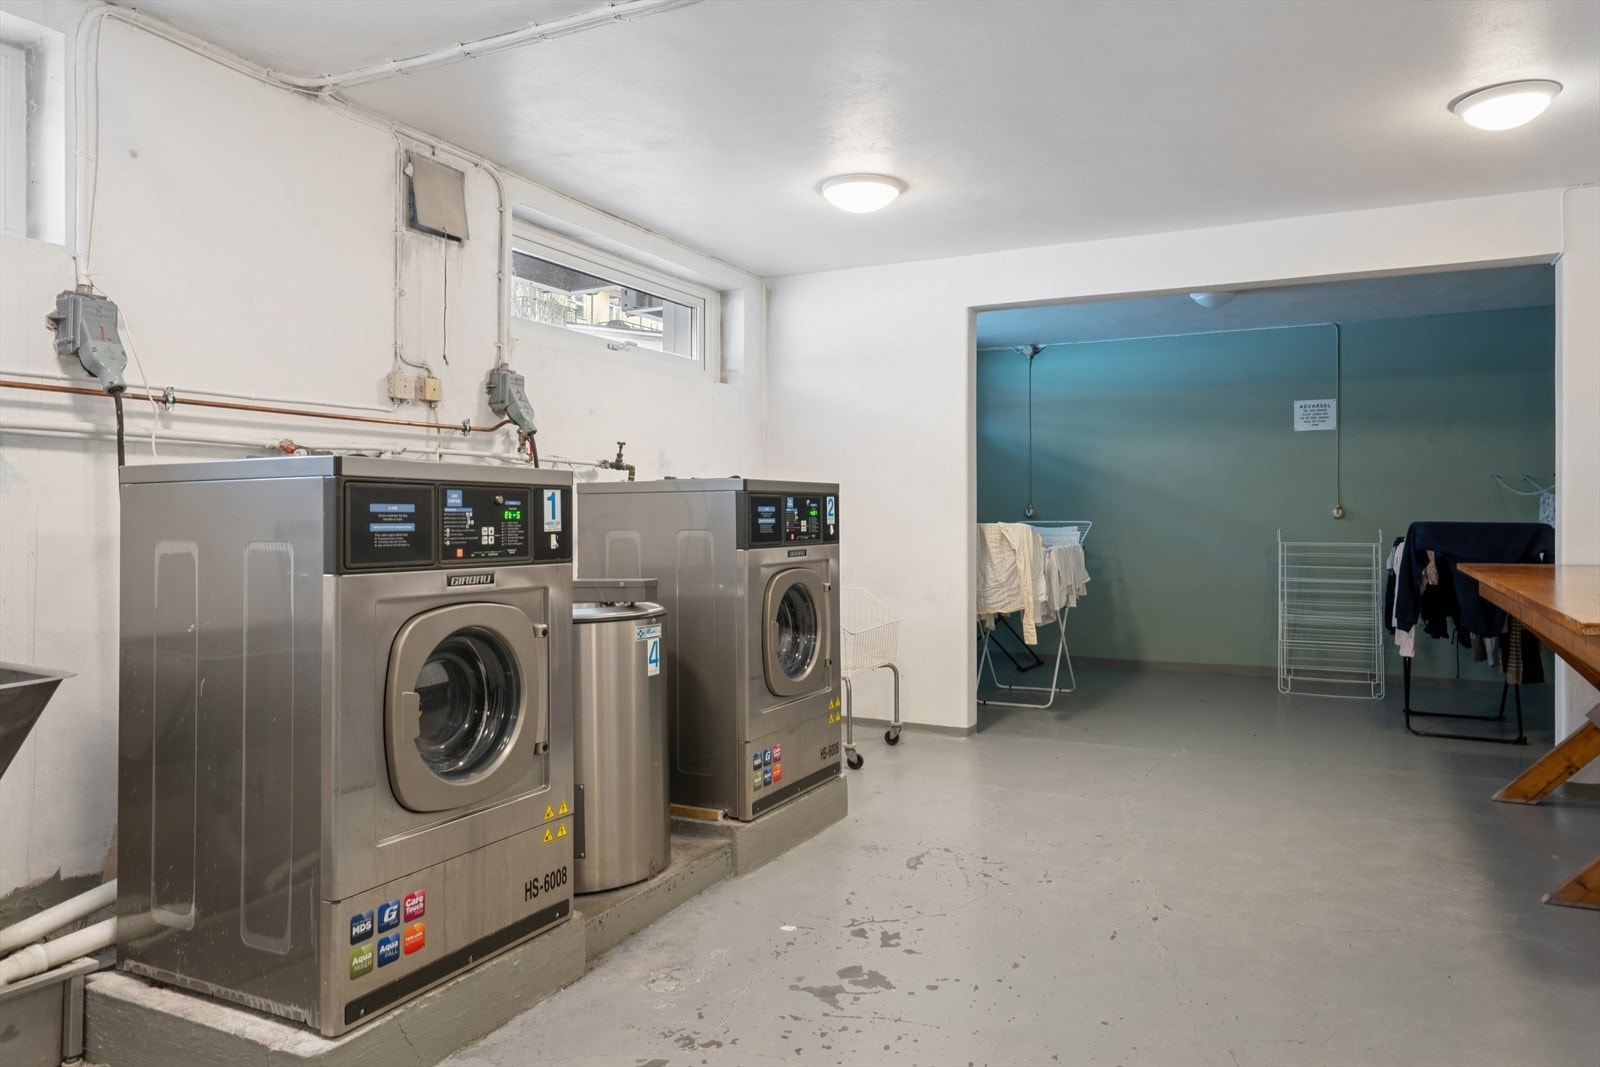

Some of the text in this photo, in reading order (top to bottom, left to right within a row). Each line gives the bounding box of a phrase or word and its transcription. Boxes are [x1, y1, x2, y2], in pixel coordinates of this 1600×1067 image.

[547, 491, 556, 520] 1
[827, 498, 834, 516] 2
[450, 574, 492, 586] GIRBAU
[649, 640, 659, 667] 4
[525, 866, 568, 902] HS-6008
[405, 895, 424, 907] Care
[406, 902, 424, 914] Touch
[384, 904, 398, 922] G
[352, 920, 372, 936] MDS
[380, 940, 399, 954] Aqua
[385, 950, 399, 959] FALL
[353, 951, 372, 966] Aqua
